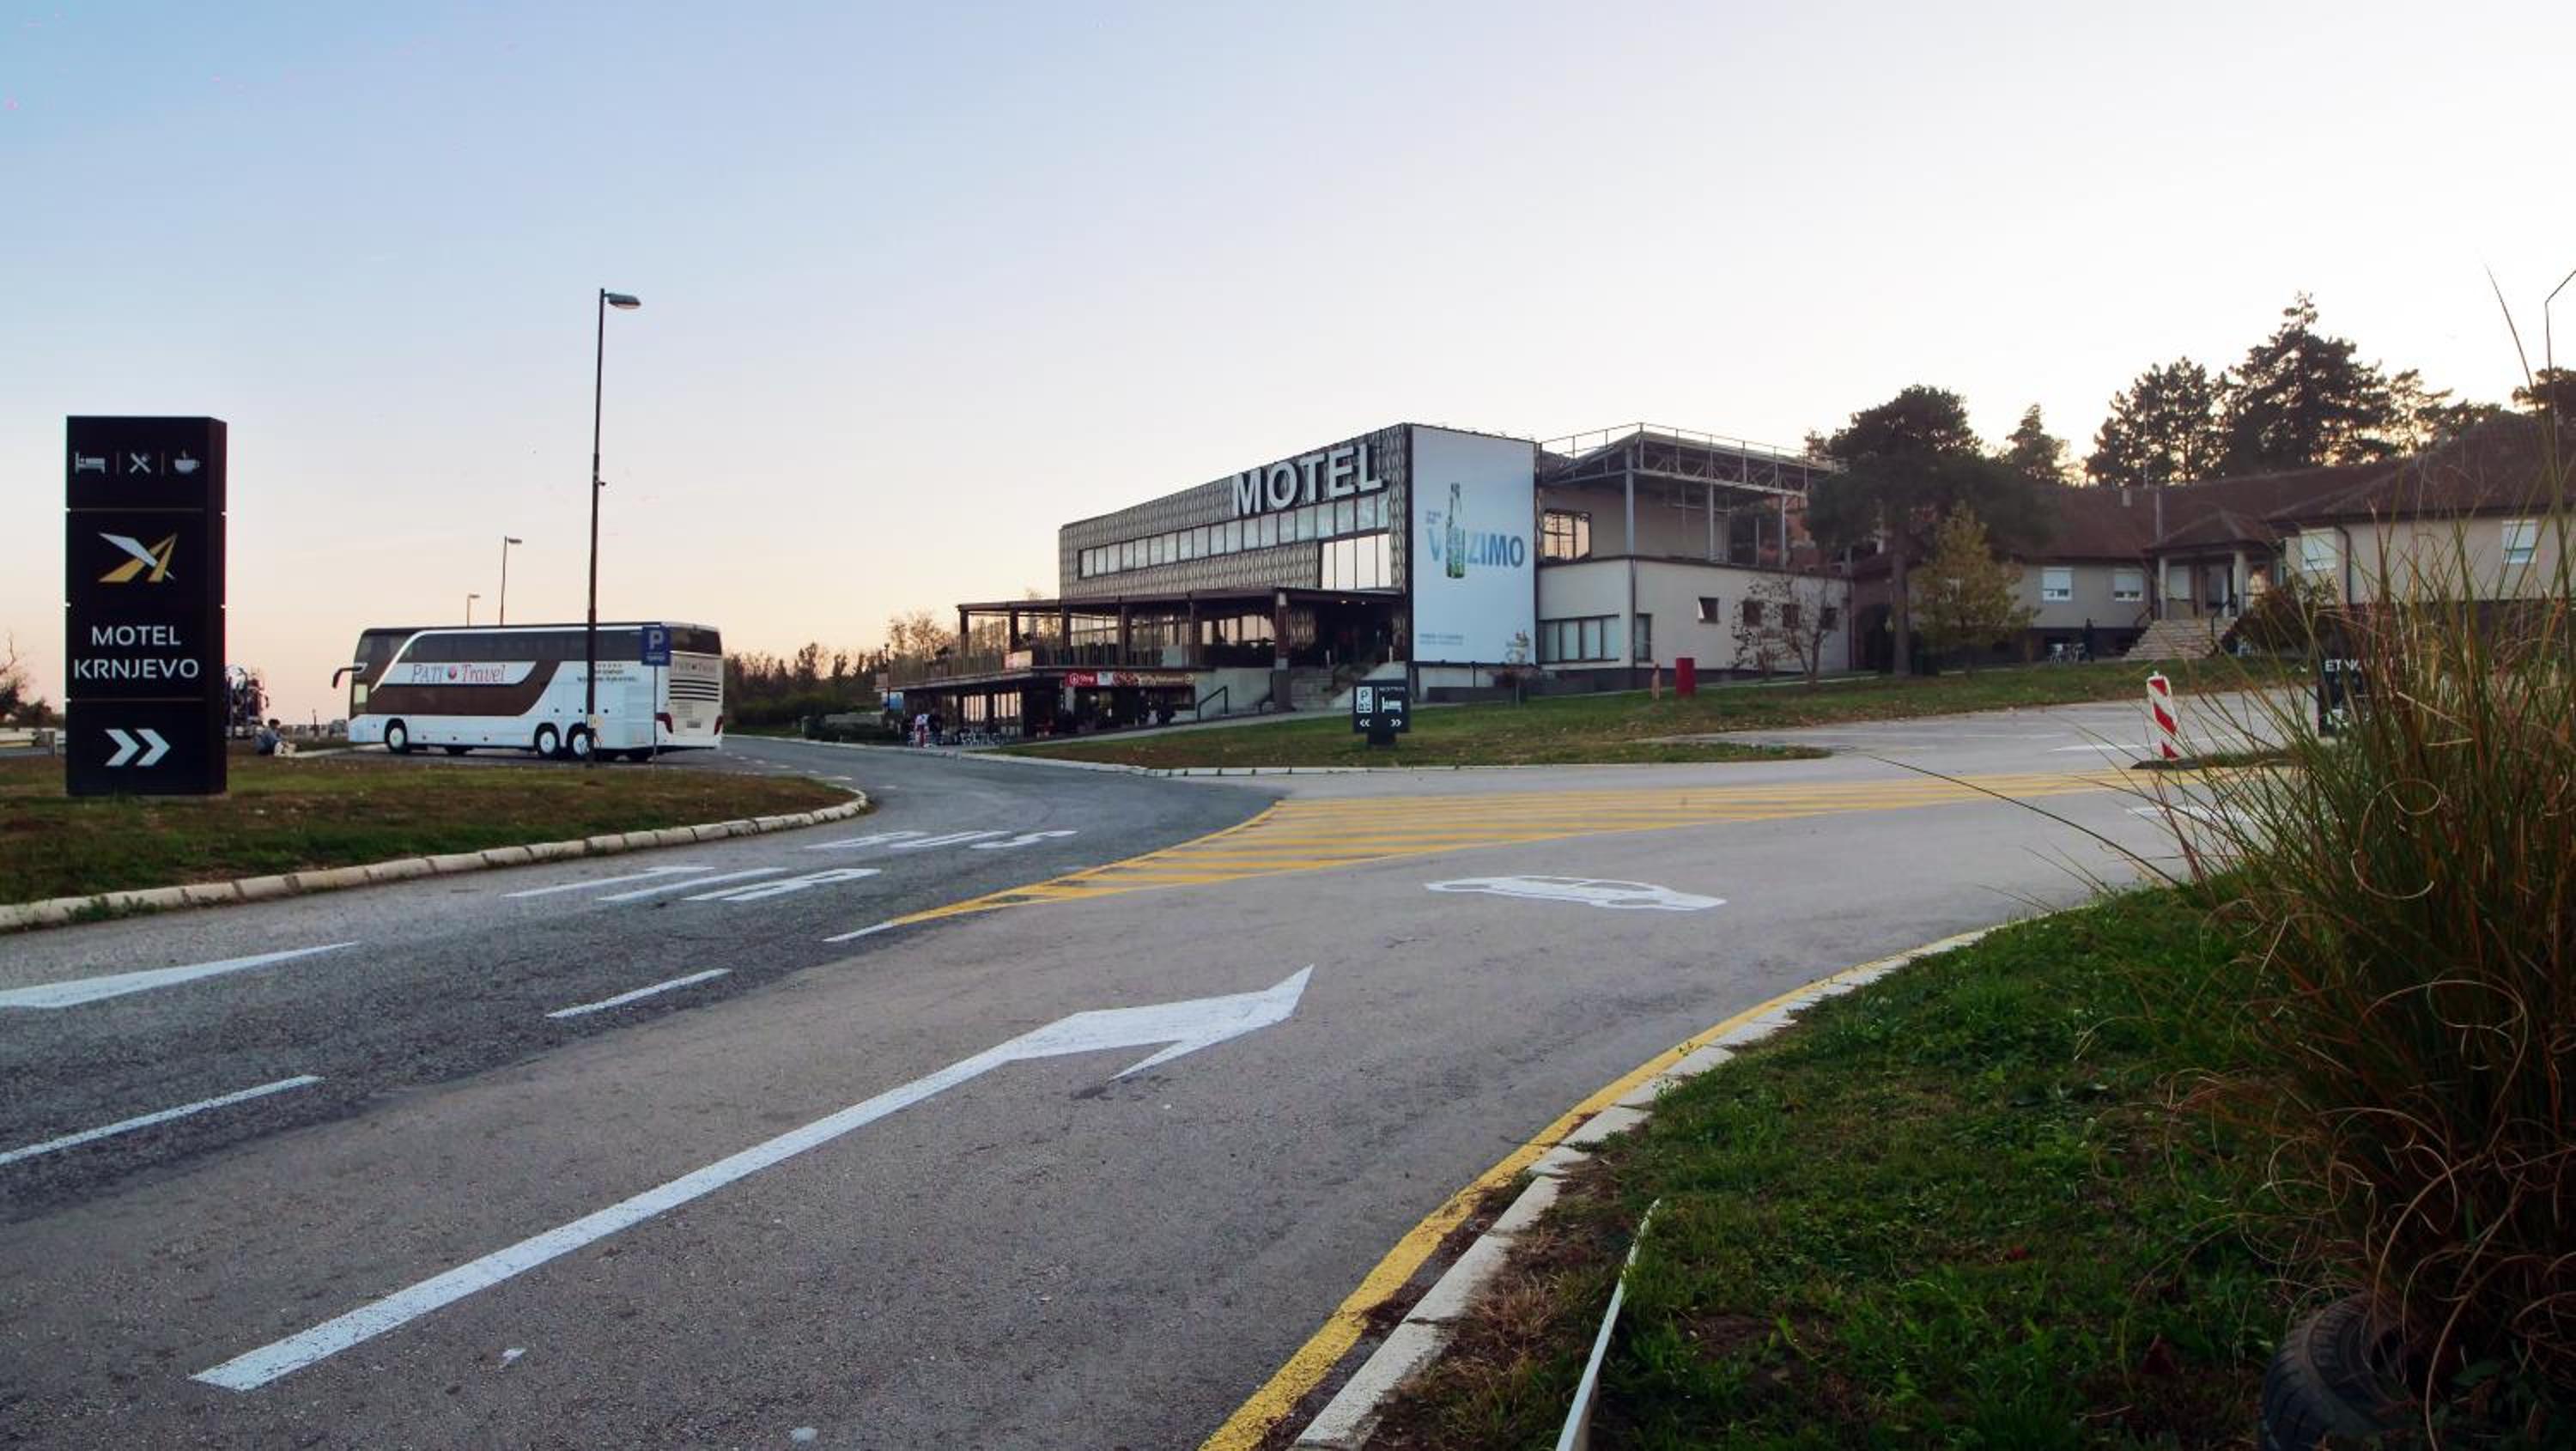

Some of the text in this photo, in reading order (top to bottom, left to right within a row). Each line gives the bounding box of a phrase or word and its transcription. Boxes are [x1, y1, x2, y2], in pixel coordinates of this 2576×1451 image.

[1231, 443, 1382, 516] MOTEL
[91, 625, 181, 646] MOTEL
[649, 629, 664, 650] P
[74, 659, 199, 679] KRNJEVO
[461, 664, 506, 683] Travel
[804, 830, 1078, 848] BUS
[502, 866, 882, 901] TIR
